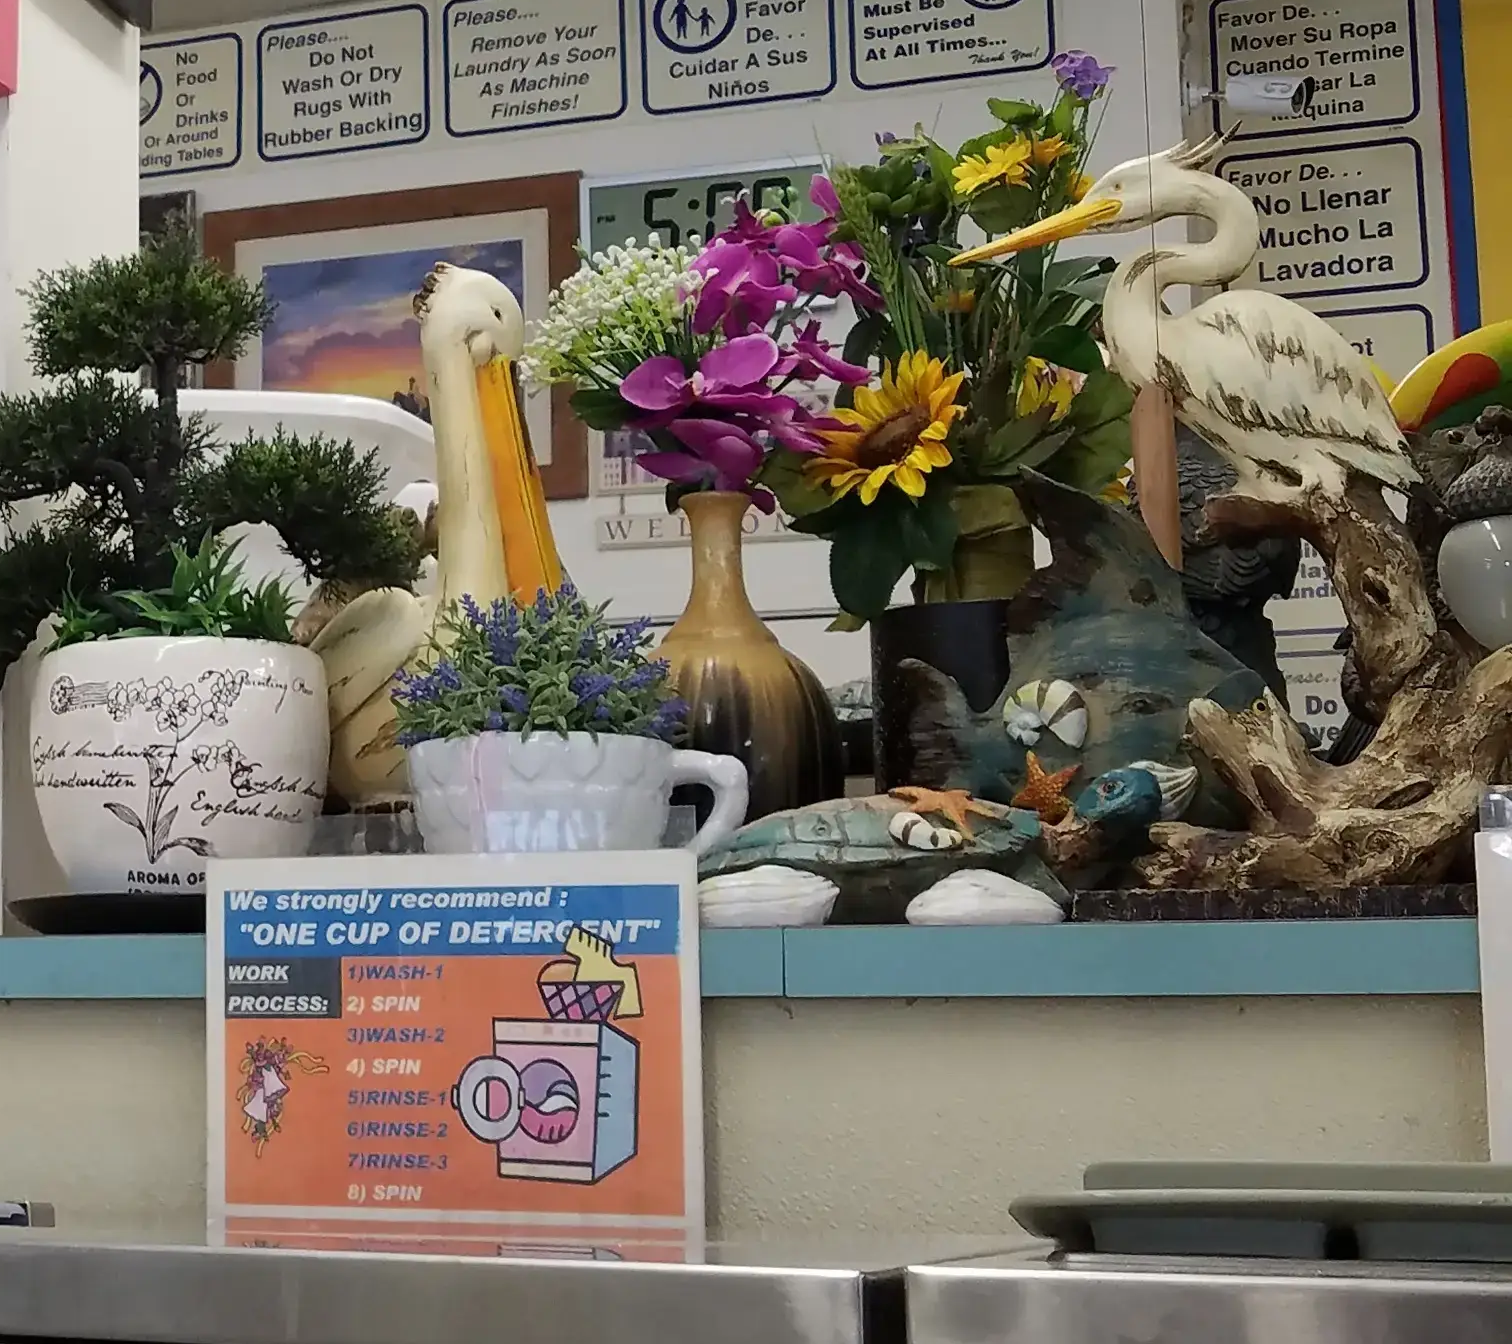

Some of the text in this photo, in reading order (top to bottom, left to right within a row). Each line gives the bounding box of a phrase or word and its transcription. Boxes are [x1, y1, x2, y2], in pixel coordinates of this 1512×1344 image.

[863, 0, 912, 19] Must
[1218, 9, 1277, 28] Favor
[863, 14, 975, 40] Supervised
[1230, 20, 1397, 52] Mover Su Ropa
[471, 24, 597, 53] Remove Your
[865, 34, 1007, 62] At All Times...
[176, 52, 198, 66] No
[309, 44, 374, 68] Do Not
[454, 45, 616, 78] Laundry As Soon
[669, 48, 808, 79] Cuidar A Sus
[968, 47, 1039, 65] Thank You!
[1226, 44, 1404, 77] Cuando Termine
[176, 68, 217, 86] Food
[283, 66, 402, 95] Wash Or Dry
[480, 71, 590, 97] As Machine
[1349, 71, 1377, 88] La
[708, 79, 770, 99] Niños
[176, 93, 196, 107] Or
[293, 90, 391, 118] Rugs With
[491, 94, 579, 120] Finishes!
[176, 110, 229, 128] Drinks
[144, 127, 219, 148] Or Around
[264, 112, 422, 148] Rubber Backing
[141, 146, 223, 167] ding Tables
[1229, 167, 1292, 187] Favor
[1253, 185, 1391, 216] No Llenar
[1259, 218, 1394, 248] Mucho La
[1258, 253, 1394, 283] Lavadora
[1305, 695, 1338, 715] Do
[191, 790, 261, 826] English
[128, 870, 180, 885] AROMA
[229, 888, 552, 914] We strongly recommend
[326, 922, 390, 946] CUP
[399, 922, 440, 944] OF
[228, 965, 290, 984] WORK
[347, 964, 444, 982] 1)WASH-1
[228, 995, 328, 1014] PROCESS:
[347, 996, 421, 1013] 2) SPIN
[347, 1027, 445, 1045] 3)WASH-2
[347, 1059, 421, 1077] 4) SPIN
[347, 1090, 446, 1107] 5)RINSE-1
[347, 1121, 447, 1139] 6)RINSE-2
[347, 1153, 447, 1170] 7)RINSE-3
[347, 1185, 421, 1202] 8) SPIN
